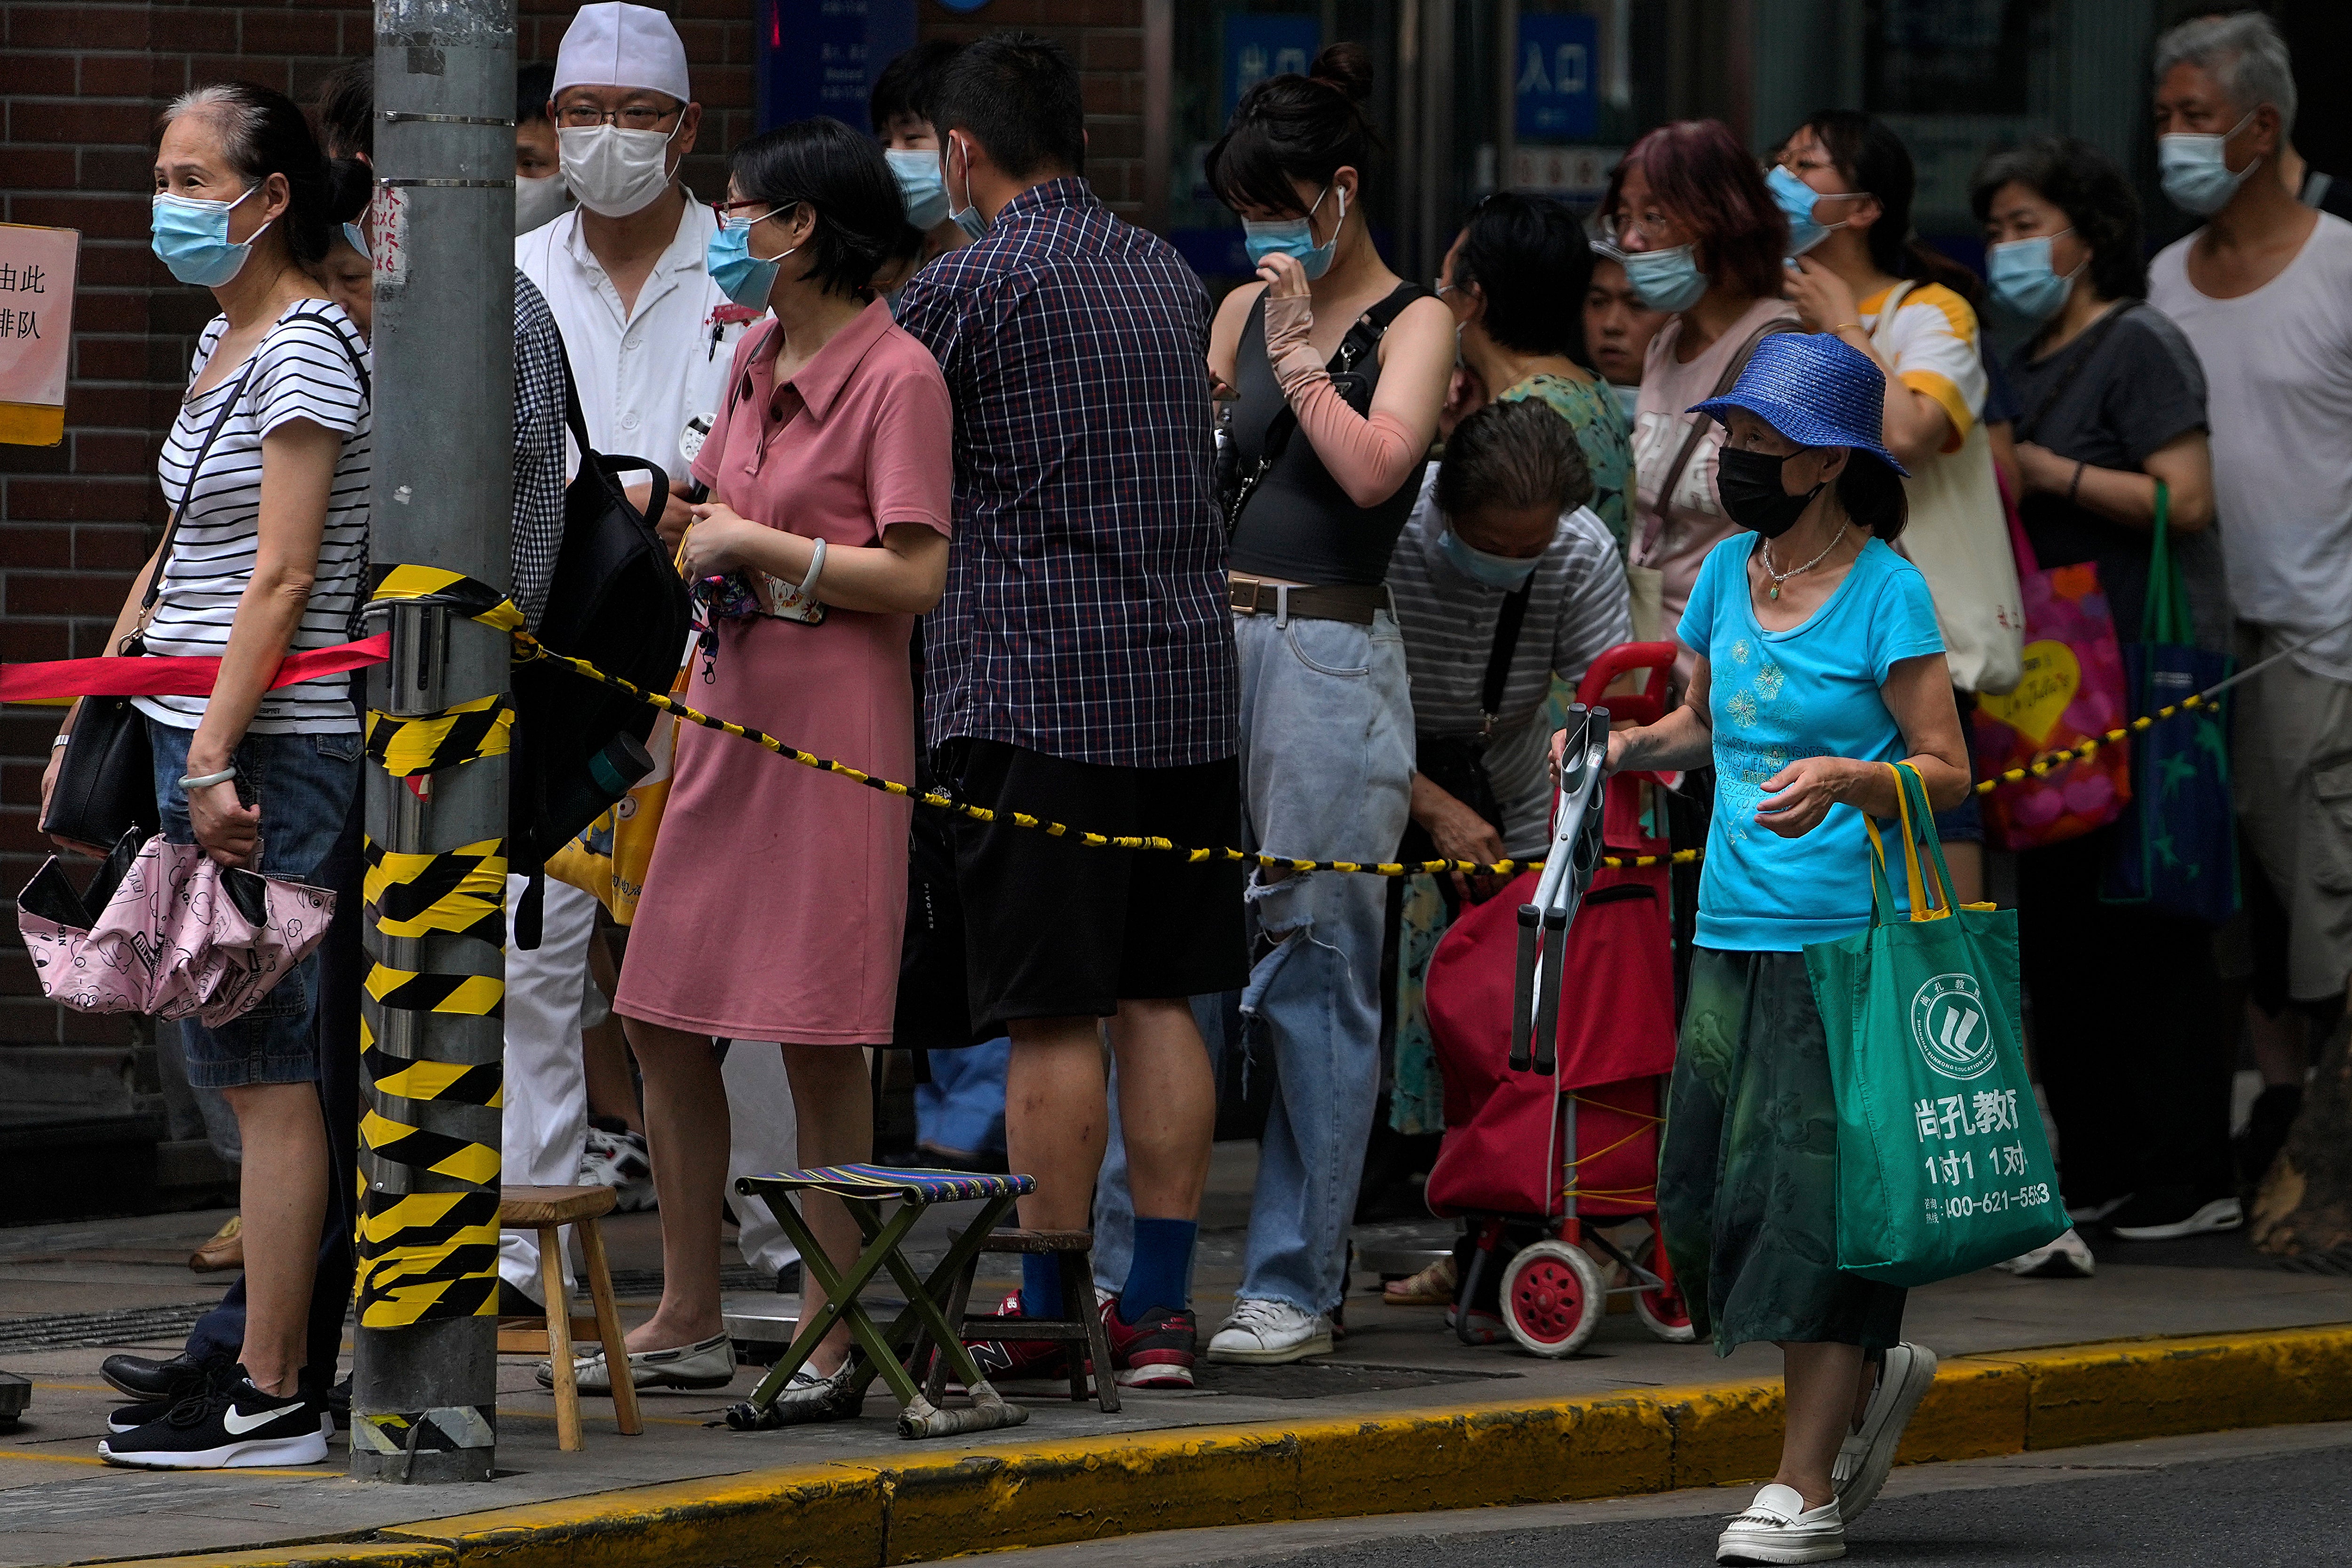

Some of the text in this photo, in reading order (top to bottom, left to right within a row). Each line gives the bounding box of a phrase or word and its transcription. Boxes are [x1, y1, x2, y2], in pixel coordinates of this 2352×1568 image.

[1516, 41, 1587, 94] 入口
[0, 263, 45, 294] 由此
[1920, 979, 1980, 1006] 尚孔教
[1917, 1019, 1929, 1051] SHANGHAI
[1927, 1051, 1954, 1070] SUNKONG
[1954, 1060, 1983, 1072] EDUCATION
[1925, 1150, 1974, 1186] 1对1
